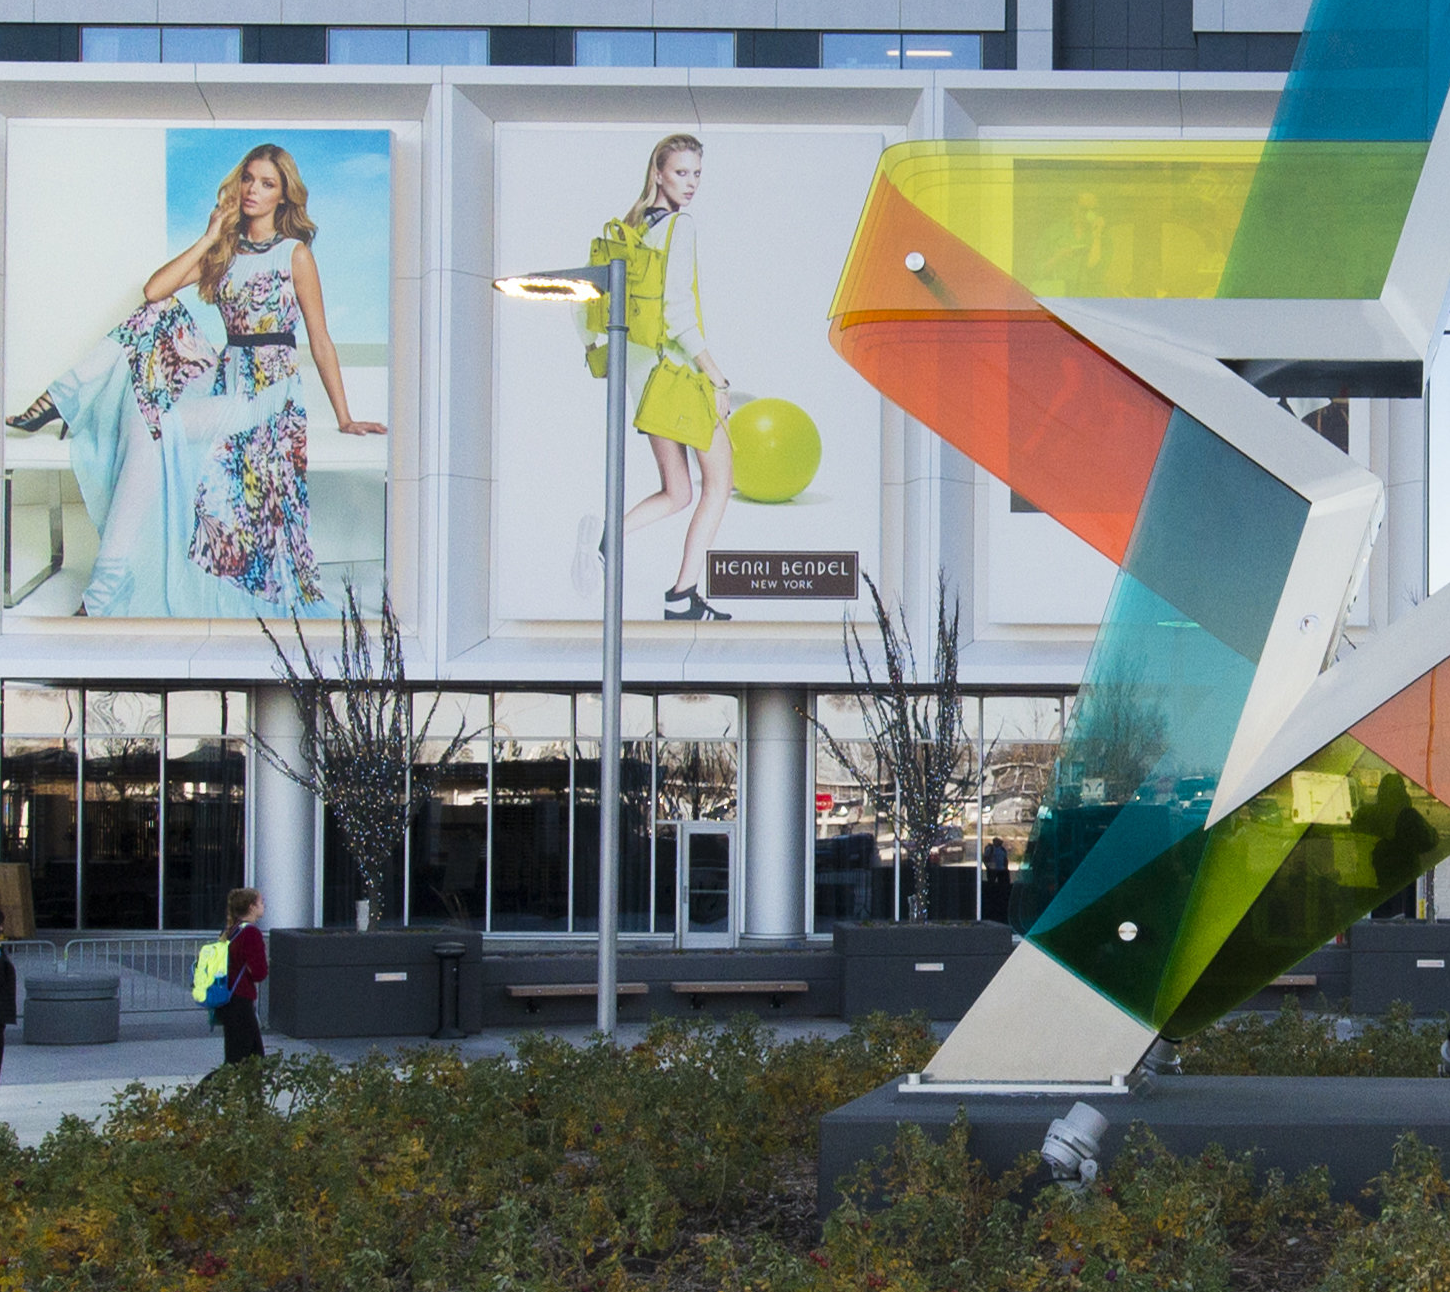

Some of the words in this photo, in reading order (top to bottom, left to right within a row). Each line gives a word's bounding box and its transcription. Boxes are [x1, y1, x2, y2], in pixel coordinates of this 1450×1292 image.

[714, 560, 770, 576] HENRI
[781, 560, 850, 576] BENDEL
[751, 579, 778, 590] NEW
[782, 579, 814, 590] YORK
